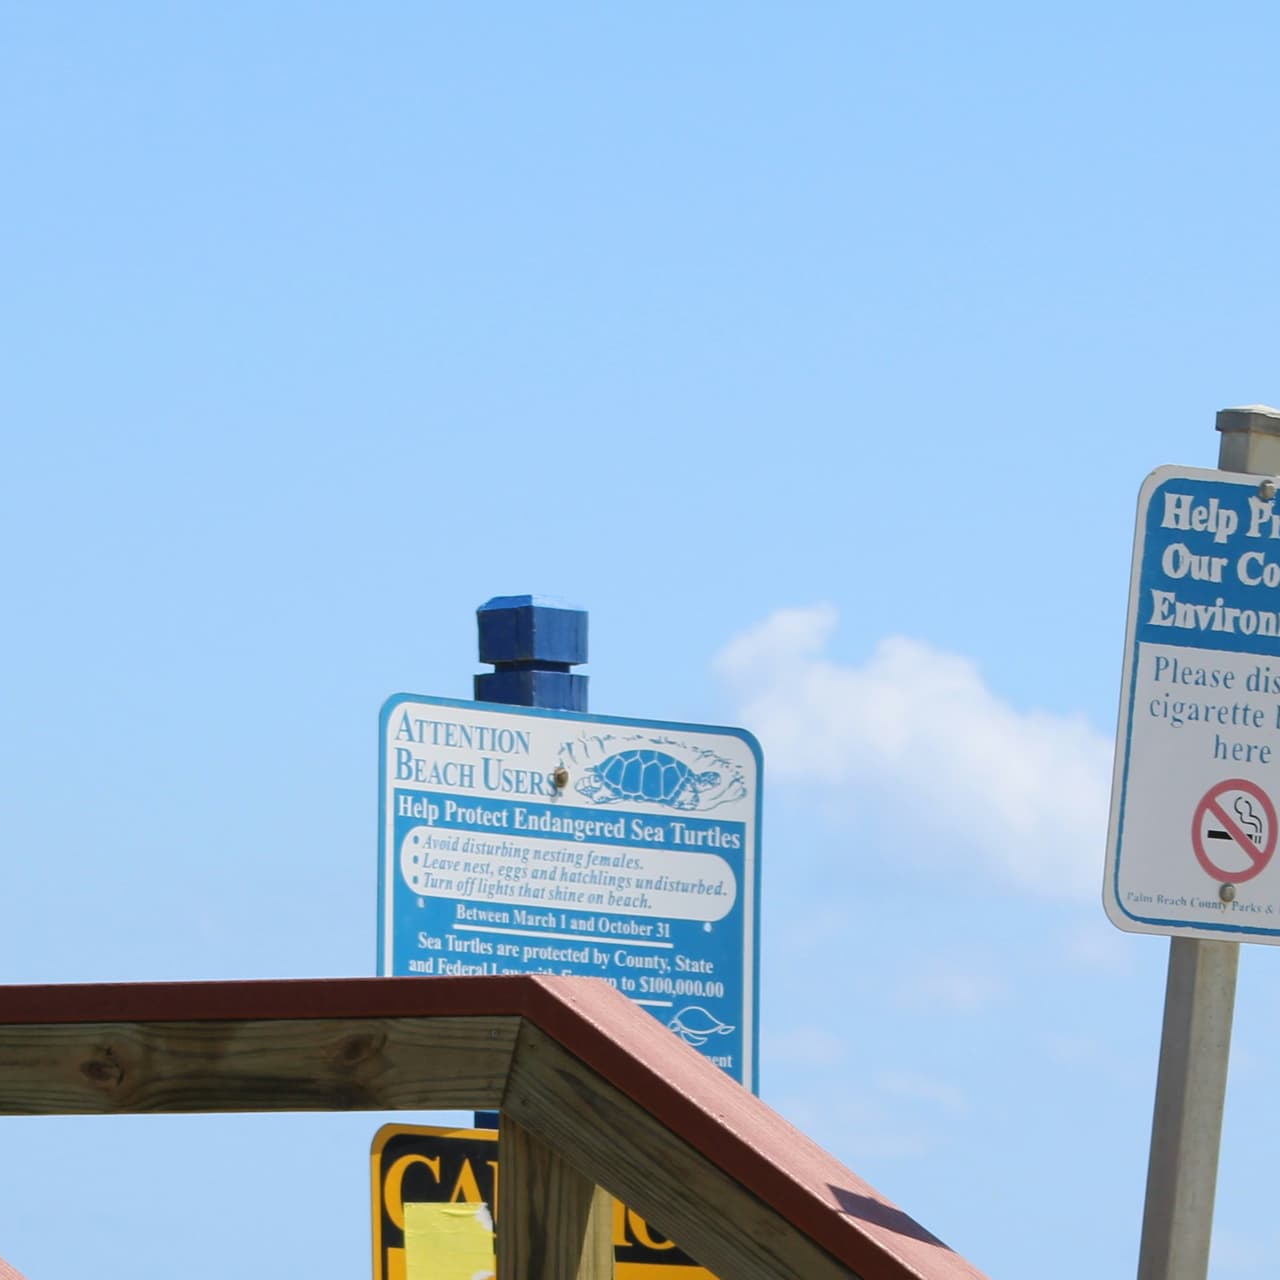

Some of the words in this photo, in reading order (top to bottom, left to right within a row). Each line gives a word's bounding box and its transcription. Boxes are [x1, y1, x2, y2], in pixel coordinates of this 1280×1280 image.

[1160, 492, 1238, 544] Help
[1162, 543, 1228, 583] Our
[1154, 656, 1234, 689] Please
[1150, 693, 1264, 728] cigarette
[1214, 734, 1271, 764] here
[399, 795, 439, 825] Help
[445, 800, 508, 827] Protect
[514, 807, 625, 841] Endangered
[631, 819, 664, 842] Sea
[671, 822, 741, 848] Turtles
[422, 834, 460, 851] Avoid
[462, 838, 529, 863] disturbing
[533, 846, 584, 868] nesting
[584, 851, 644, 870] females.
[423, 853, 460, 871] Leave
[464, 858, 494, 876] nest,
[498, 867, 528, 881] eggs
[531, 866, 558, 881] and
[560, 869, 632, 891] hatchlings
[636, 876, 727, 896] undisturbed.
[423, 873, 452, 890] Turn
[456, 877, 476, 896] off
[478, 878, 515, 899] lights
[518, 883, 545, 899] that
[548, 885, 584, 903] shine
[587, 894, 604, 905] on
[608, 891, 652, 909] beach.
[1127, 892, 1152, 904] Palm
[1157, 894, 1188, 906] Beach
[1190, 897, 1227, 913] County
[1232, 900, 1261, 913] Parks
[457, 904, 509, 924] Between
[513, 909, 556, 928] March
[560, 914, 566, 929] 1
[570, 917, 594, 932] and
[598, 917, 653, 937] October
[656, 922, 670, 938] 31
[418, 932, 441, 950] Sea
[445, 934, 493, 955] Turtles
[497, 943, 519, 957] are
[523, 946, 589, 964] protected
[593, 948, 610, 969] by
[614, 950, 671, 974] County,
[675, 955, 714, 974] State
[409, 957, 434, 974] and
[438, 958, 488, 976] Federal
[622, 976, 636, 991] to
[639, 975, 724, 998] $100,000.00
